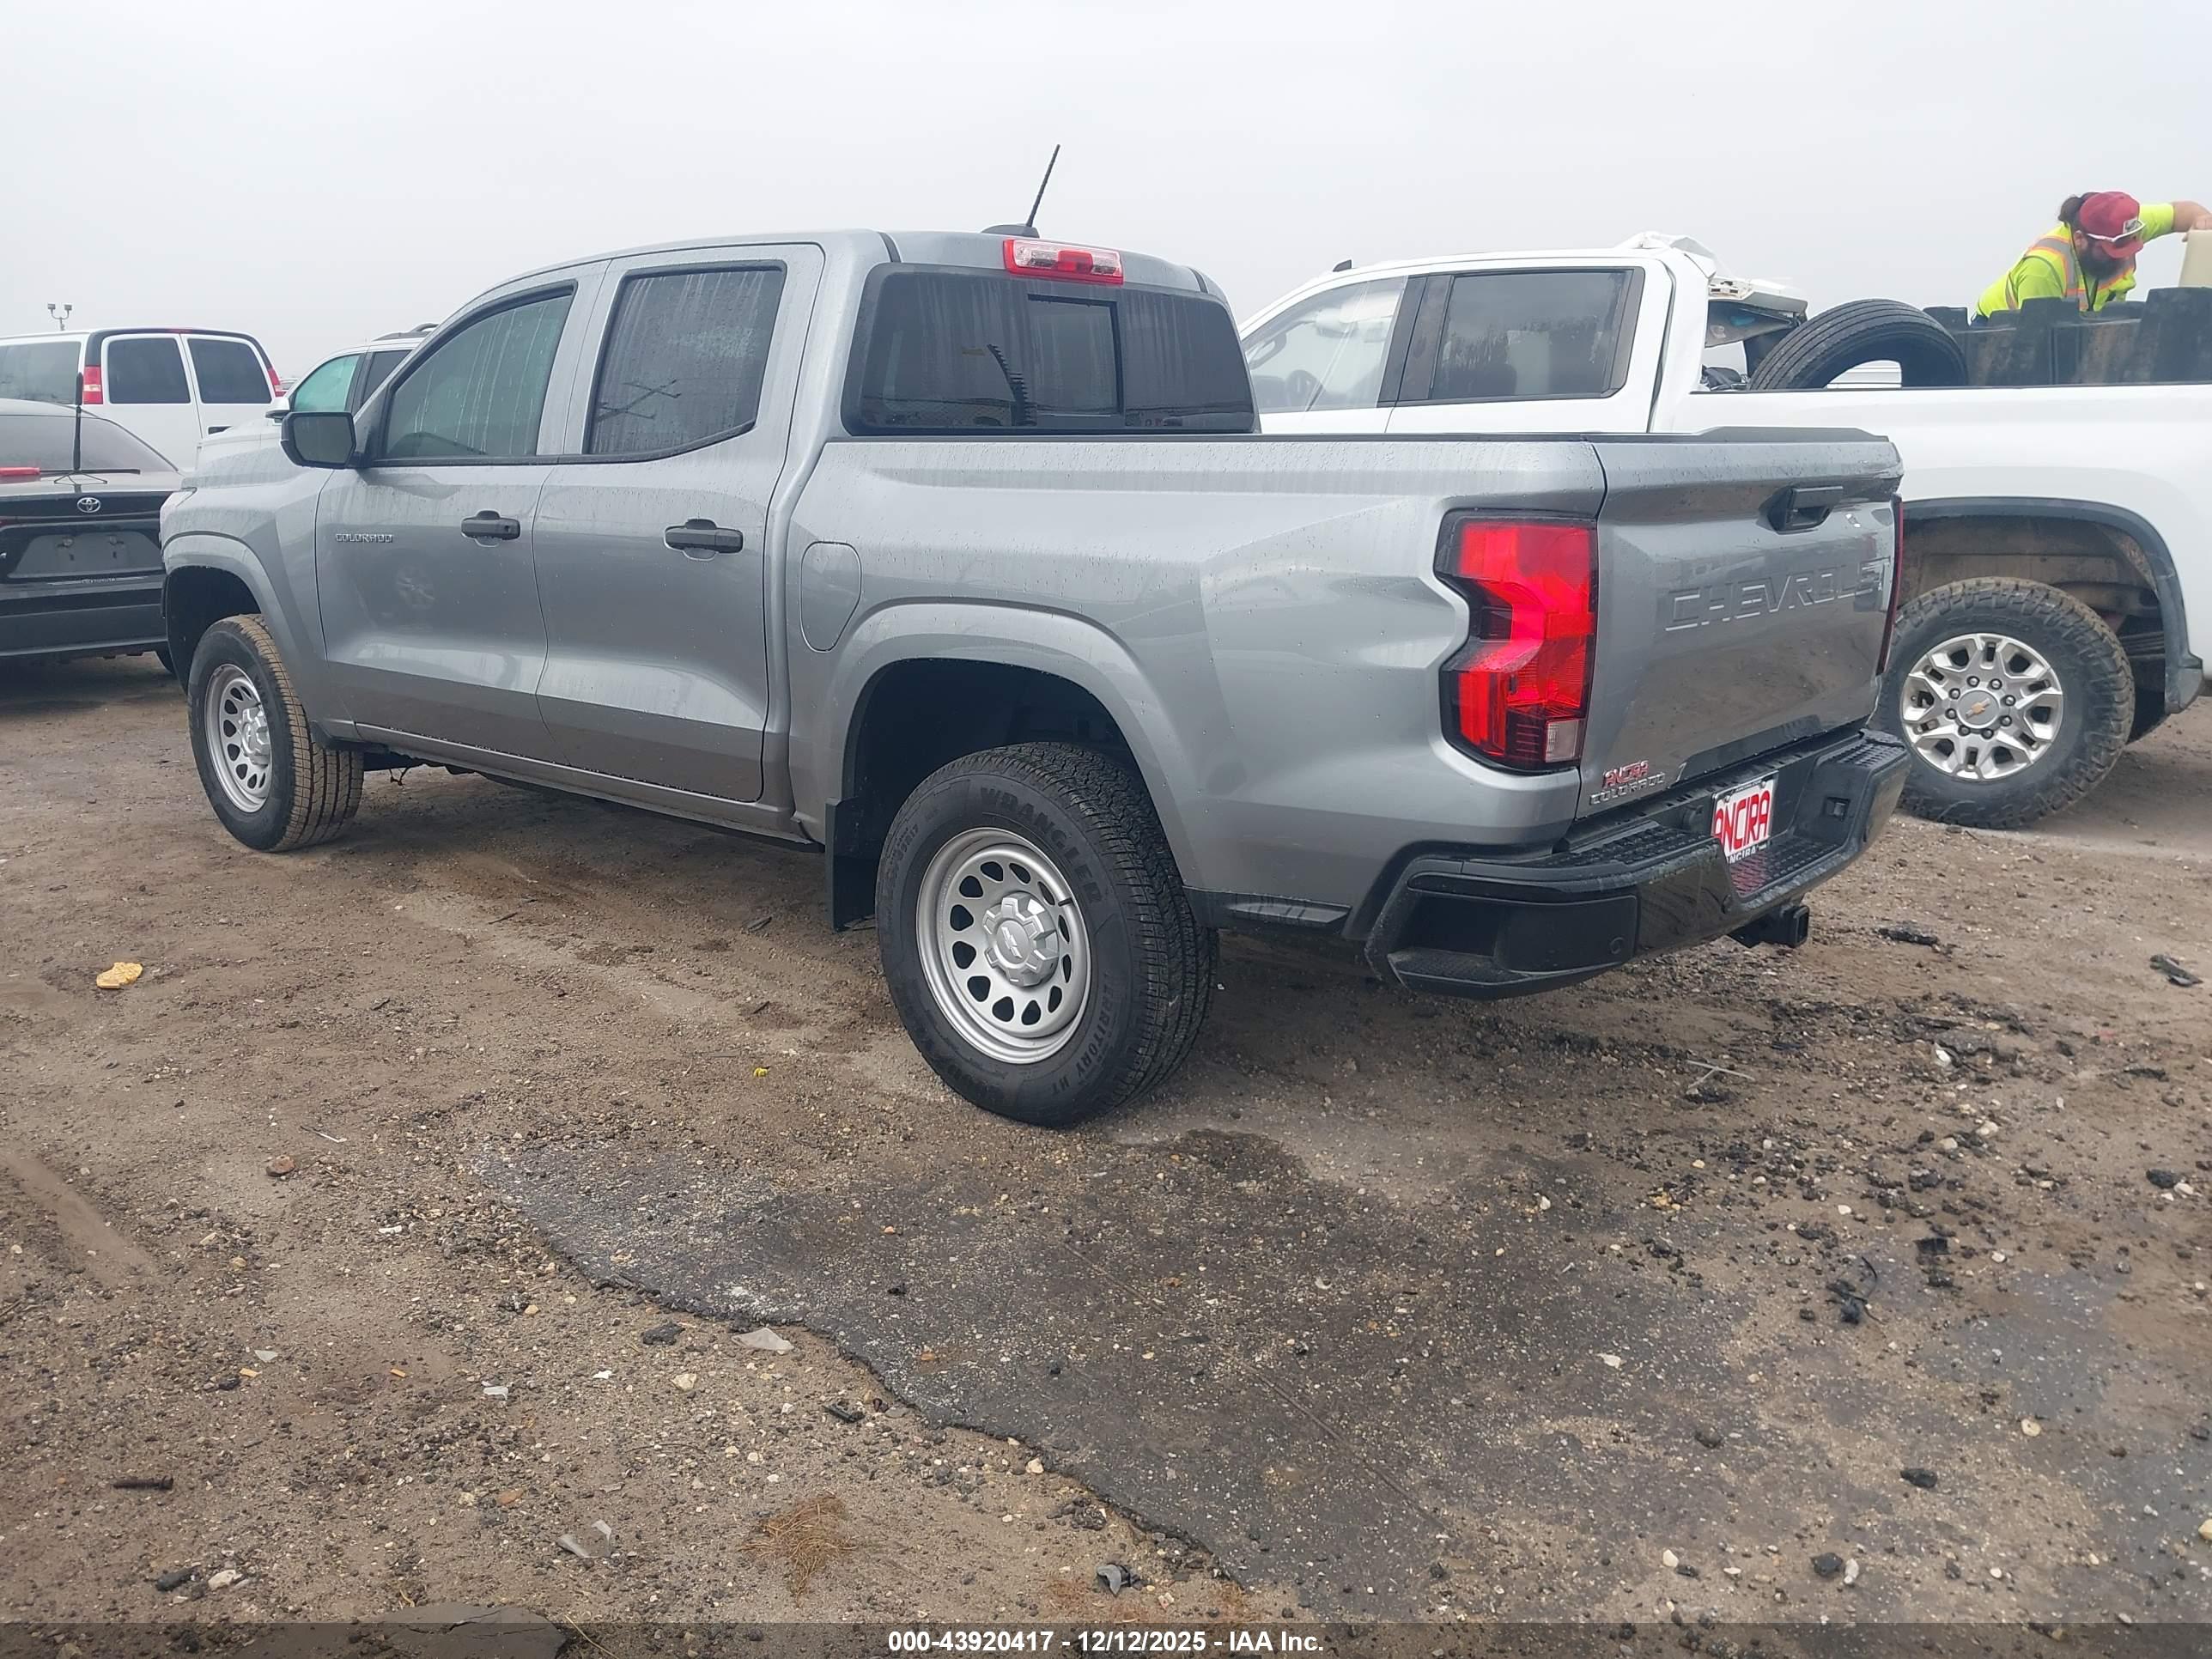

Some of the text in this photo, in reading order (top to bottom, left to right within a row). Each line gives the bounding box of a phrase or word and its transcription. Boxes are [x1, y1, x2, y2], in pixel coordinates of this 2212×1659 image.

[336, 533, 393, 543] COLORADO
[1589, 772, 1666, 805] COLORADO
[1714, 790, 1771, 853] ANCIRA
[981, 787, 1103, 903] WRANGLER
[1726, 845, 1757, 865] NCIRA
